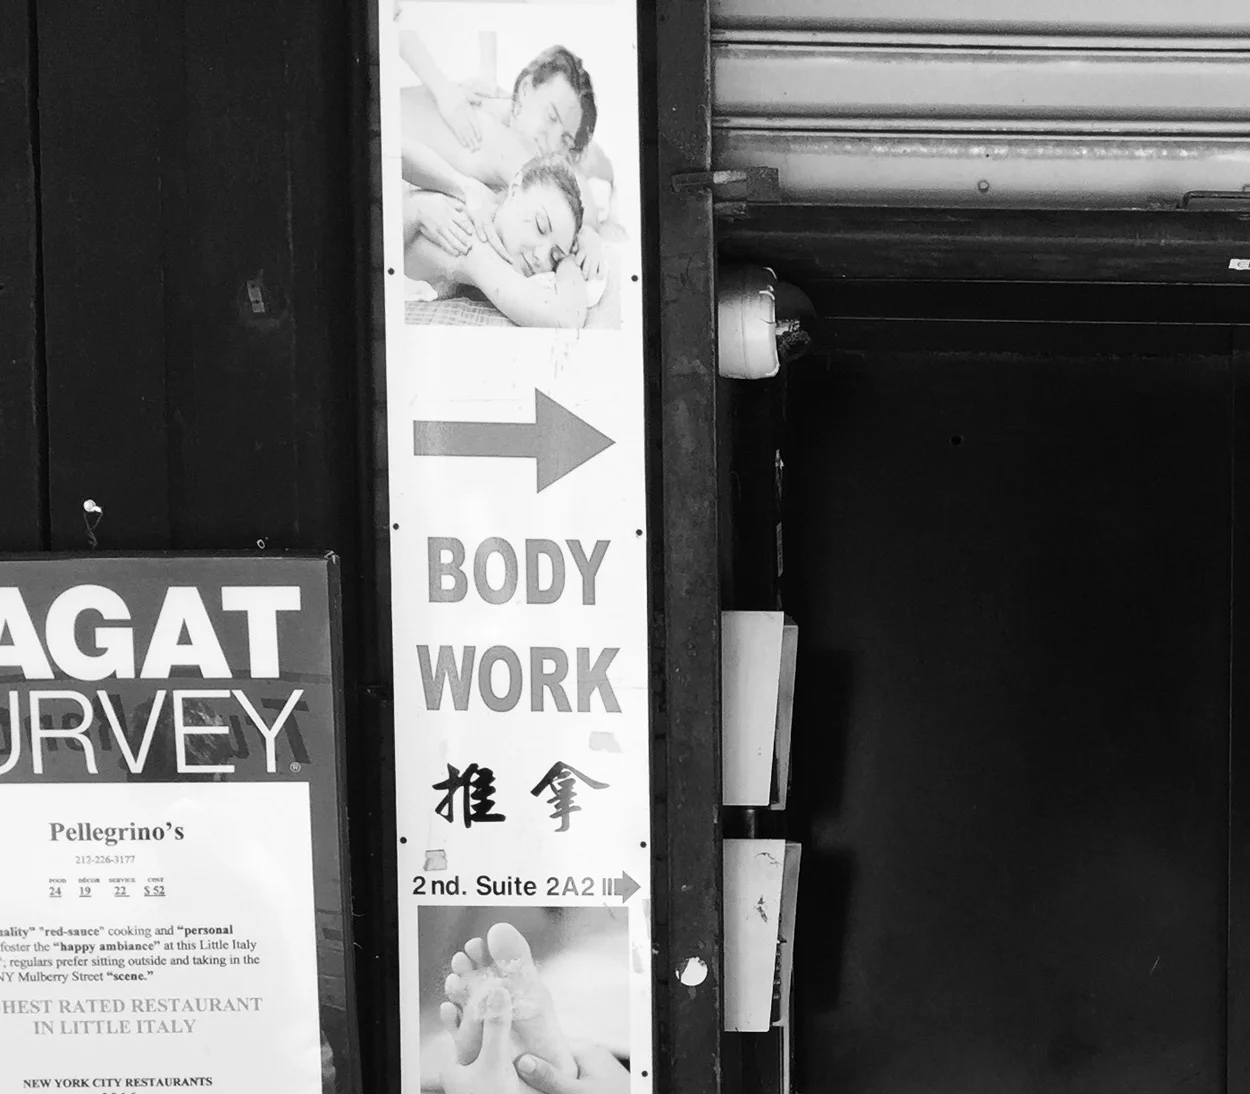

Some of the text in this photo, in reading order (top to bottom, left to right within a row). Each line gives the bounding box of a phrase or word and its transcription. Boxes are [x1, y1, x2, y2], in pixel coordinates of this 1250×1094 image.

[427, 537, 611, 606] BODY
[416, 645, 622, 713] WORK
[432, 761, 610, 832] 推拿
[49, 822, 185, 846] Pellegrino’s
[75, 855, 136, 865] 212-226-3177
[49, 886, 62, 896] 24
[79, 886, 92, 896] 19
[114, 886, 128, 896] 22
[413, 876, 594, 897] 2nd. Suite 2A2
[108, 925, 152, 938] cooking
[155, 925, 174, 936] and
[177, 924, 233, 937] “personal
[0, 939, 257, 954] foster the “happy ambiance” at this Little Italy
[10, 956, 53, 970] regulars
[56, 956, 88, 969] prefer
[92, 956, 125, 968] sitting
[128, 955, 167, 966] outside
[170, 955, 189, 966] and
[192, 954, 227, 967] taking
[230, 954, 240, 965] in
[243, 954, 261, 965] the
[18, 971, 68, 984] Mulberry
[72, 970, 104, 981] Street
[59, 998, 126, 1013] RATED
[131, 997, 263, 1013] RESTAURANT
[33, 1019, 197, 1035] IN LITTLE ITALY
[23, 1076, 213, 1088] NEW YORK CITY RESTAURANTS
